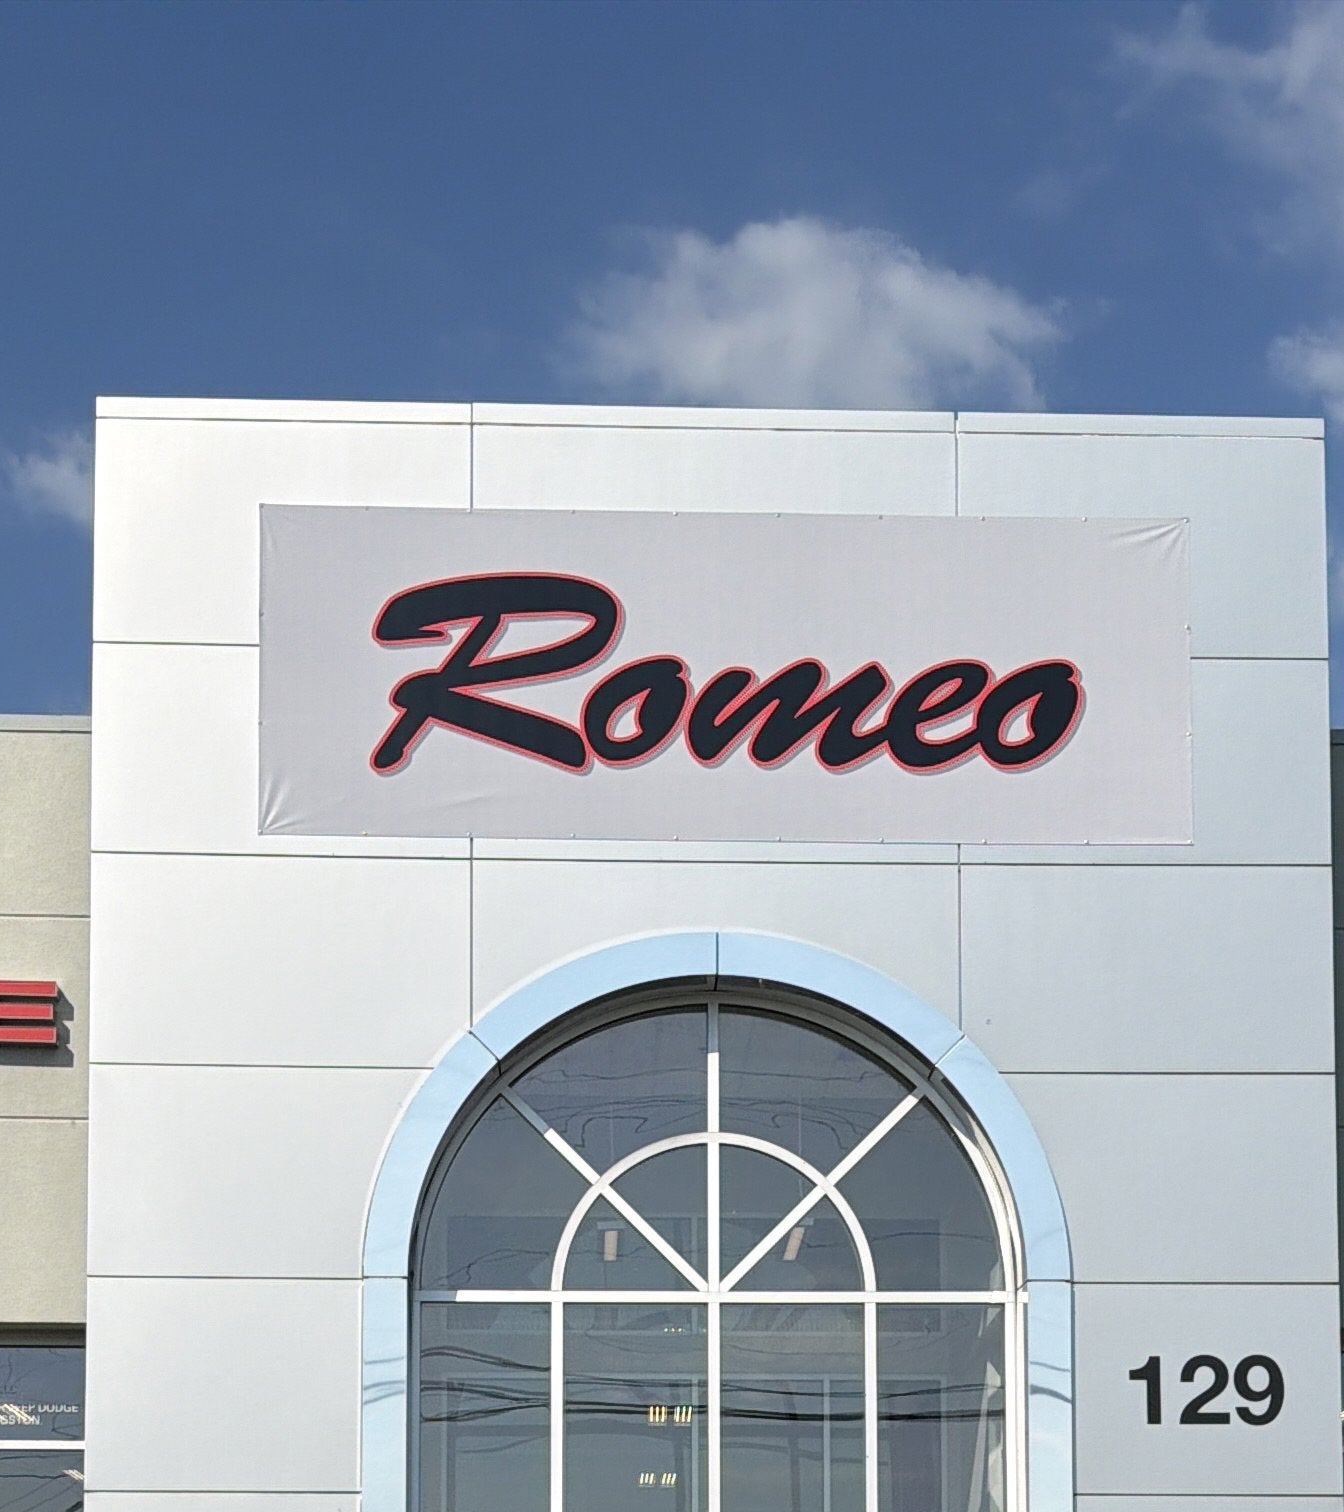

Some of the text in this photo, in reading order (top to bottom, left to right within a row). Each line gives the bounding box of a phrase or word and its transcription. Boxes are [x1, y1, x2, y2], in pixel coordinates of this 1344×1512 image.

[372, 572, 1082, 774] Romeo
[38, 1403, 79, 1412] DODGE
[1128, 1354, 1285, 1426] 129
